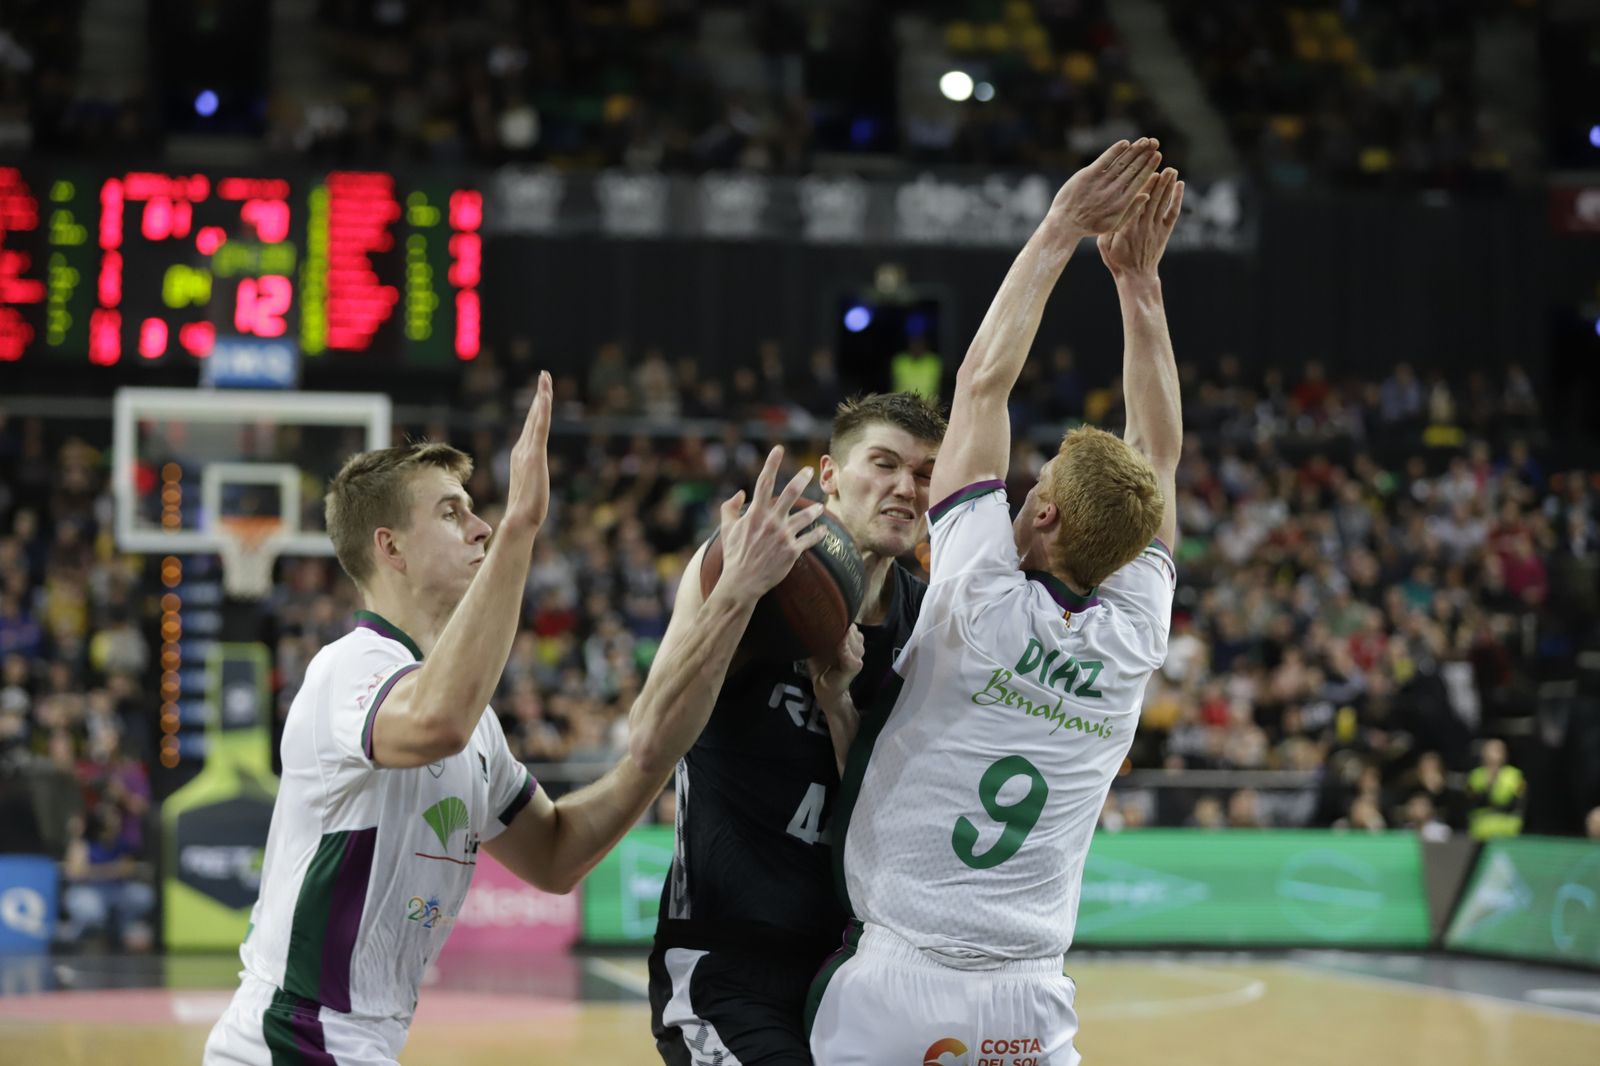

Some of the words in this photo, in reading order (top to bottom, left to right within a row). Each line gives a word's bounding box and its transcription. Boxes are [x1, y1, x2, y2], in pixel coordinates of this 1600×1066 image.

[1014, 637, 1105, 699] DIAZ
[785, 781, 833, 846] 4
[951, 754, 1050, 870] 9
[980, 1038, 1042, 1055] COSTA
